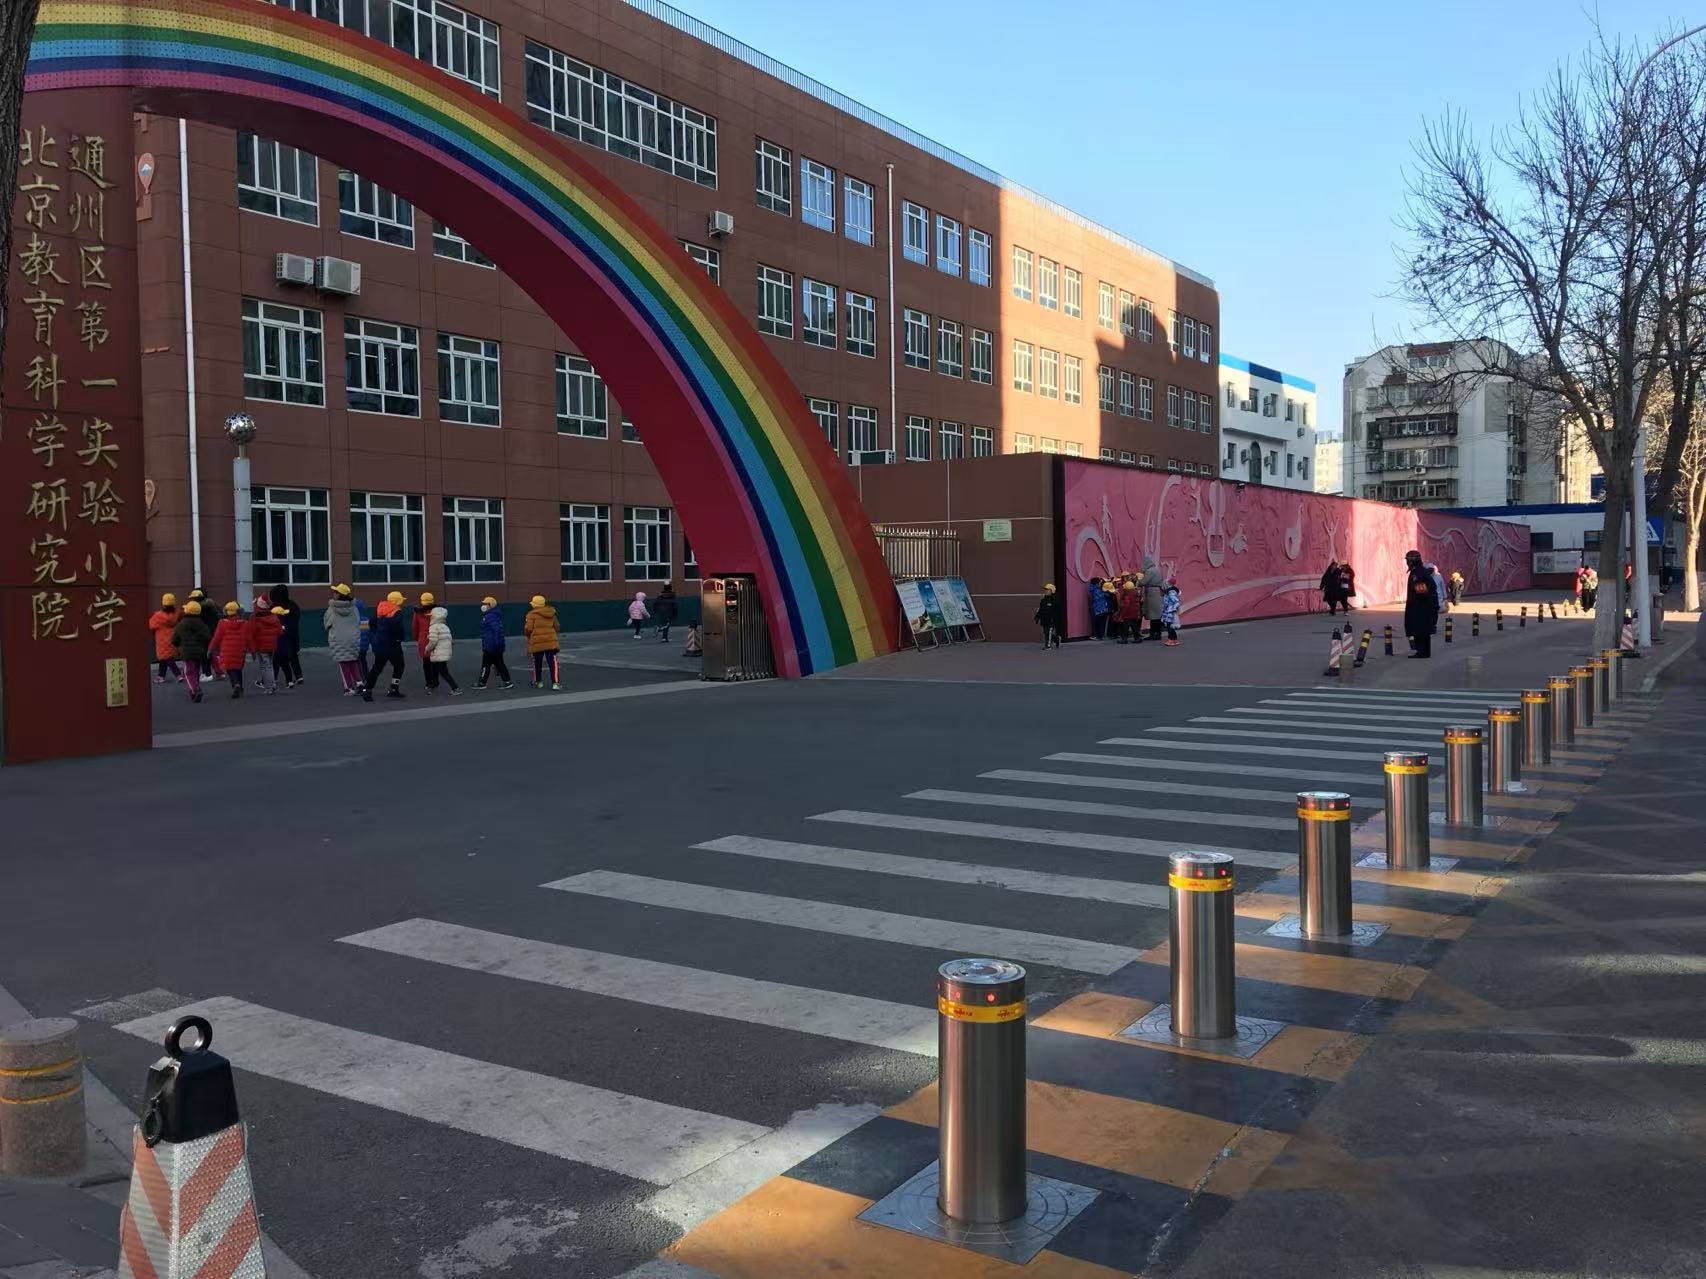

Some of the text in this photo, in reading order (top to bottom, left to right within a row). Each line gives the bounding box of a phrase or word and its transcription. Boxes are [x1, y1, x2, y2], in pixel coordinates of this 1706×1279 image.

[19, 124, 78, 641] 北京教育科学研究院
[67, 135, 127, 642] 通州区第一实验小学
